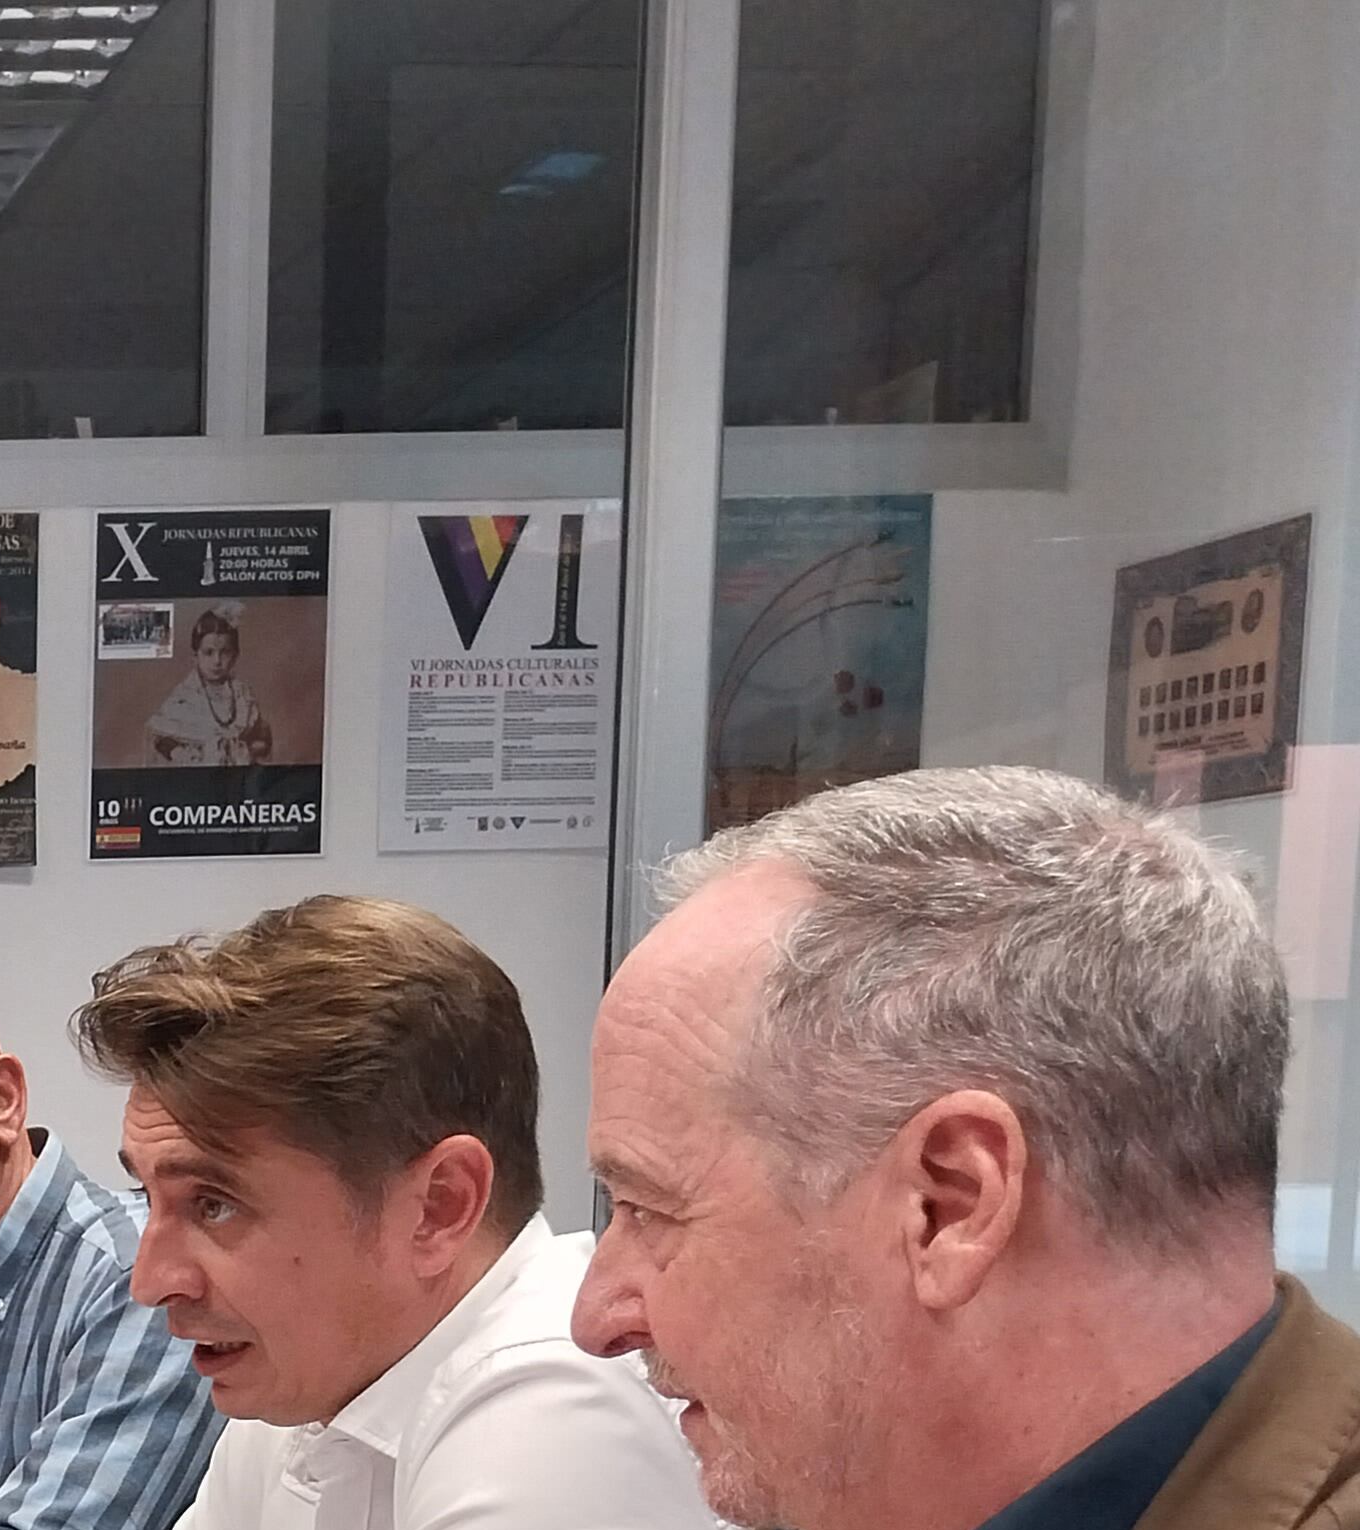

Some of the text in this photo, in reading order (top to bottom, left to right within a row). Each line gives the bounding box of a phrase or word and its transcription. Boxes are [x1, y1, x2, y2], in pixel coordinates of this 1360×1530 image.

[162, 526, 318, 543] JORNADAS REPUBLICANAS
[101, 522, 160, 583] X
[265, 546, 276, 556] 14
[279, 545, 310, 555] ABRIL
[220, 559, 288, 569] 20:00 HORAS
[259, 571, 294, 581] ACTOS
[296, 570, 320, 580] DPH
[411, 658, 599, 671] VI JORNADAS CULTURALES
[409, 673, 595, 689] REPUBLICANAS
[98, 800, 120, 818] 10
[149, 800, 316, 826] COMPAÑERAS
